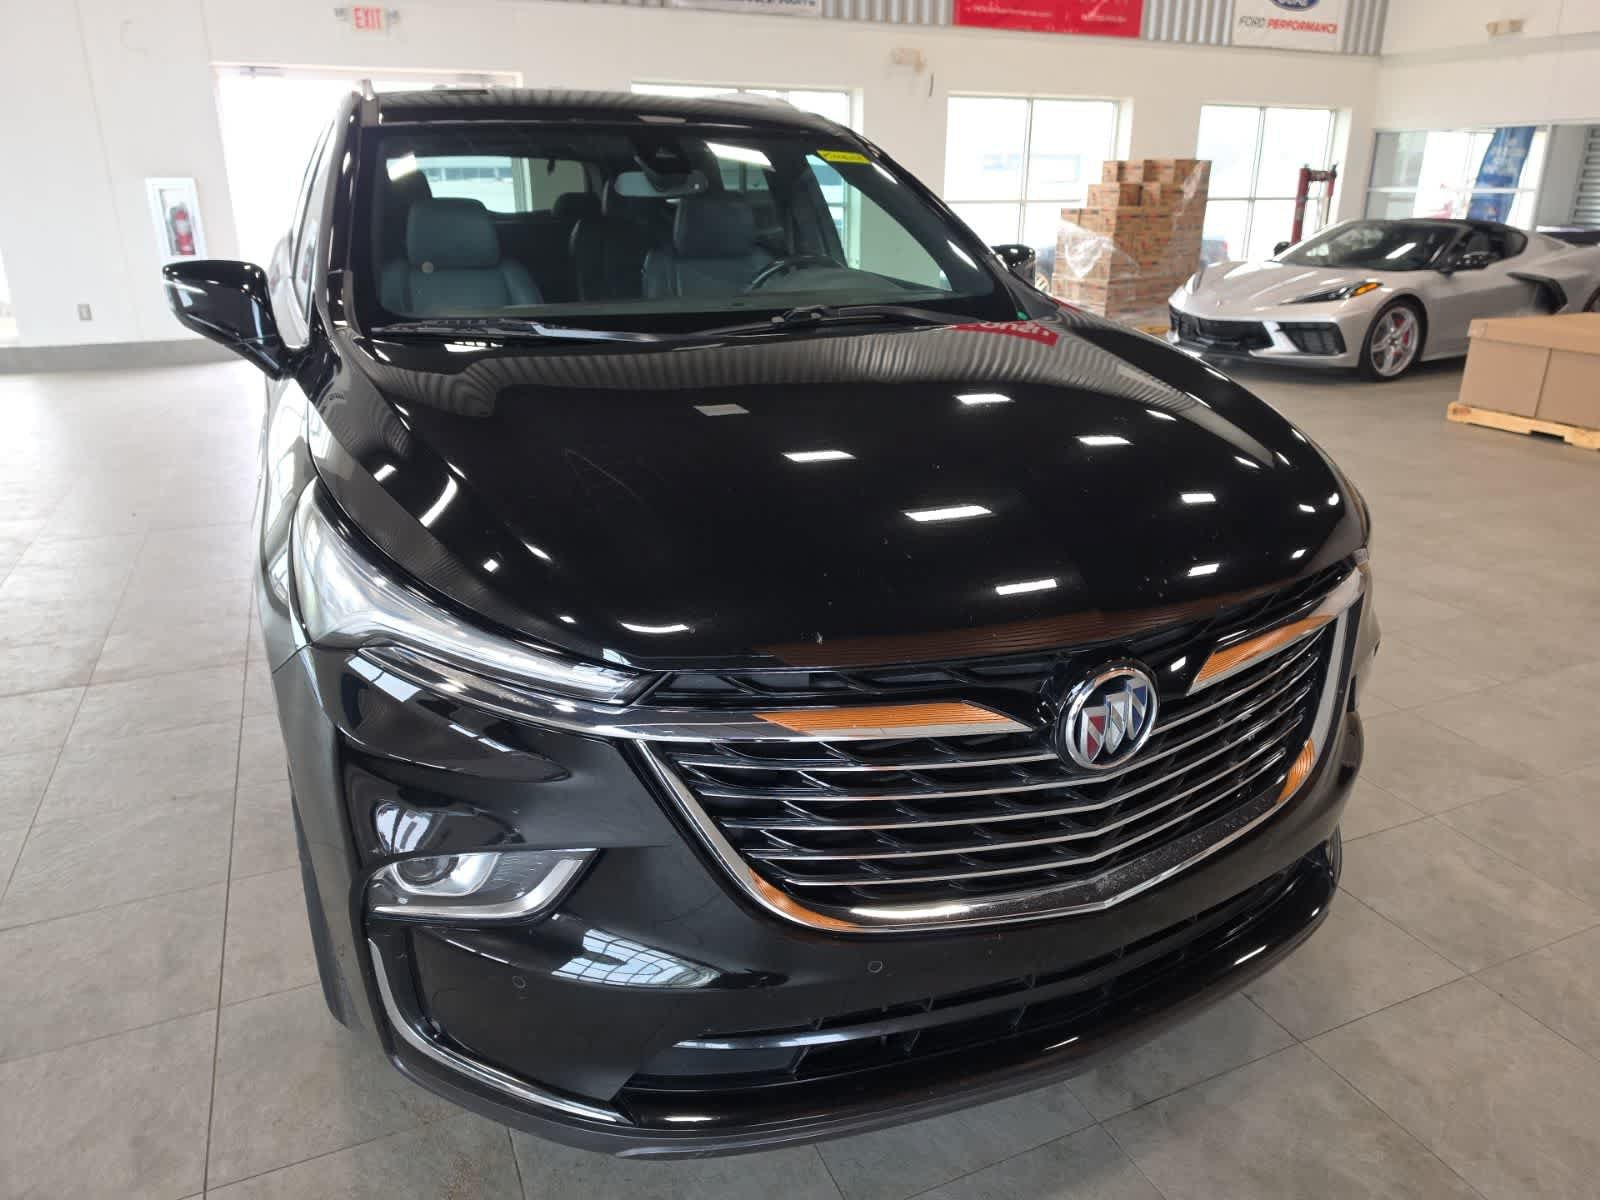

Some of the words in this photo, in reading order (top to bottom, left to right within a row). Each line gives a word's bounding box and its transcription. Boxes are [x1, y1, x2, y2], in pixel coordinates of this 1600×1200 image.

[354, 7, 382, 29] EXIT
[1240, 16, 1266, 28] FORD
[1267, 18, 1338, 33] PERFORMANCE
